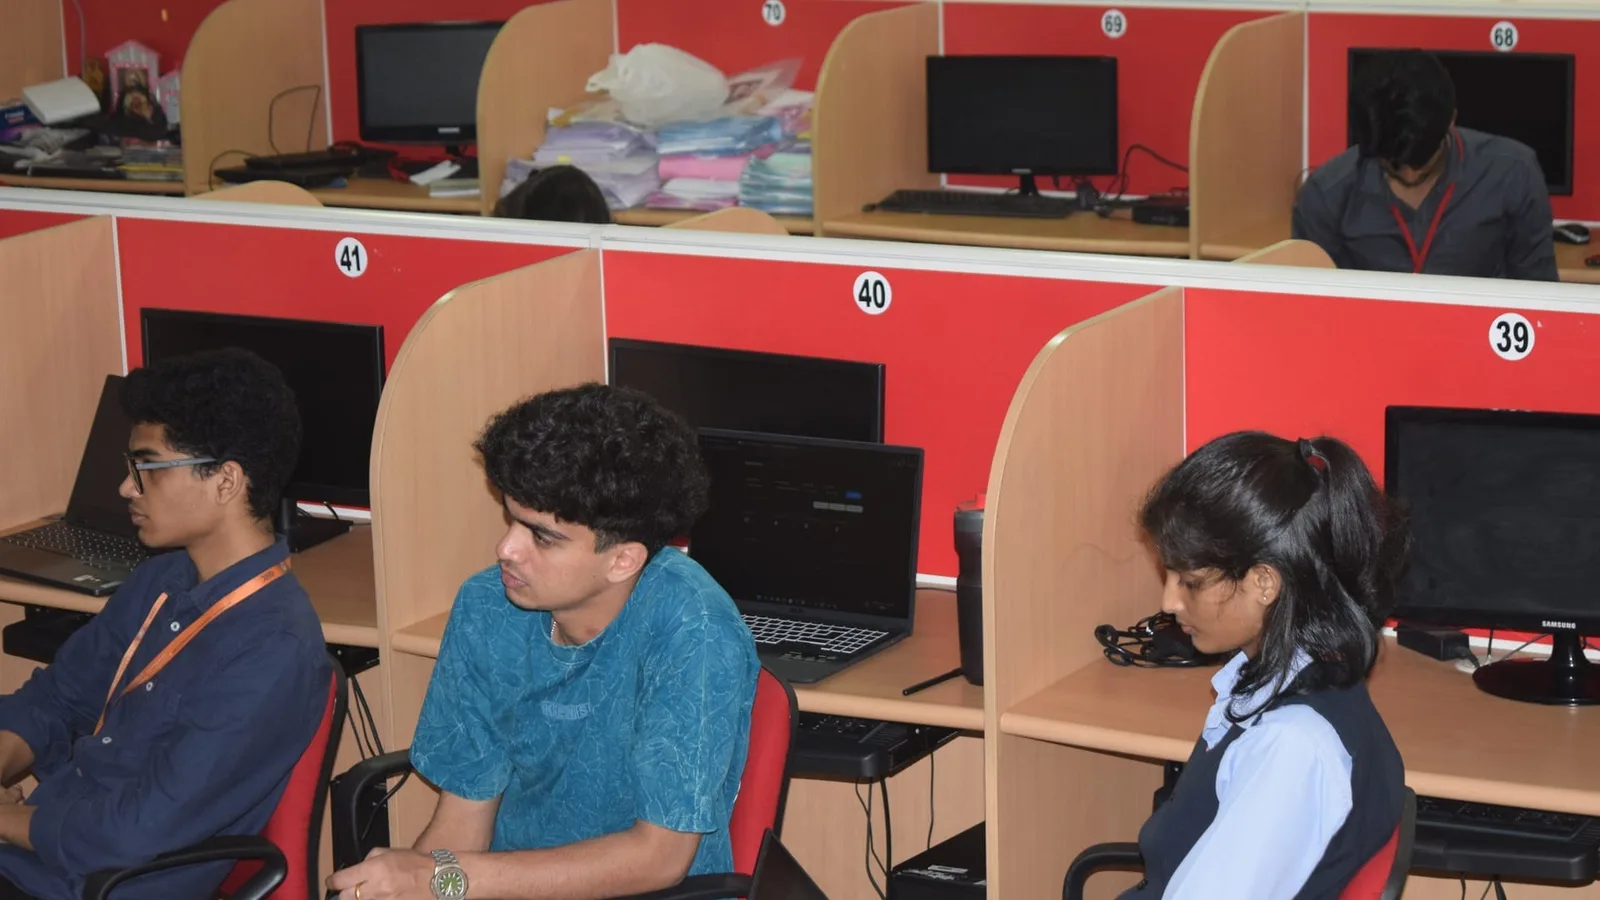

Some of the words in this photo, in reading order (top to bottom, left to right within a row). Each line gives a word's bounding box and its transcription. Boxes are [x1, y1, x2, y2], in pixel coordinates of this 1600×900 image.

[765, 3, 781, 21] 70
[1104, 15, 1123, 33] 69
[1494, 27, 1514, 46] 68
[340, 245, 361, 271] 41
[858, 279, 886, 308] 40
[1496, 321, 1529, 353] 39
[1541, 620, 1576, 629] SAMSUNG
